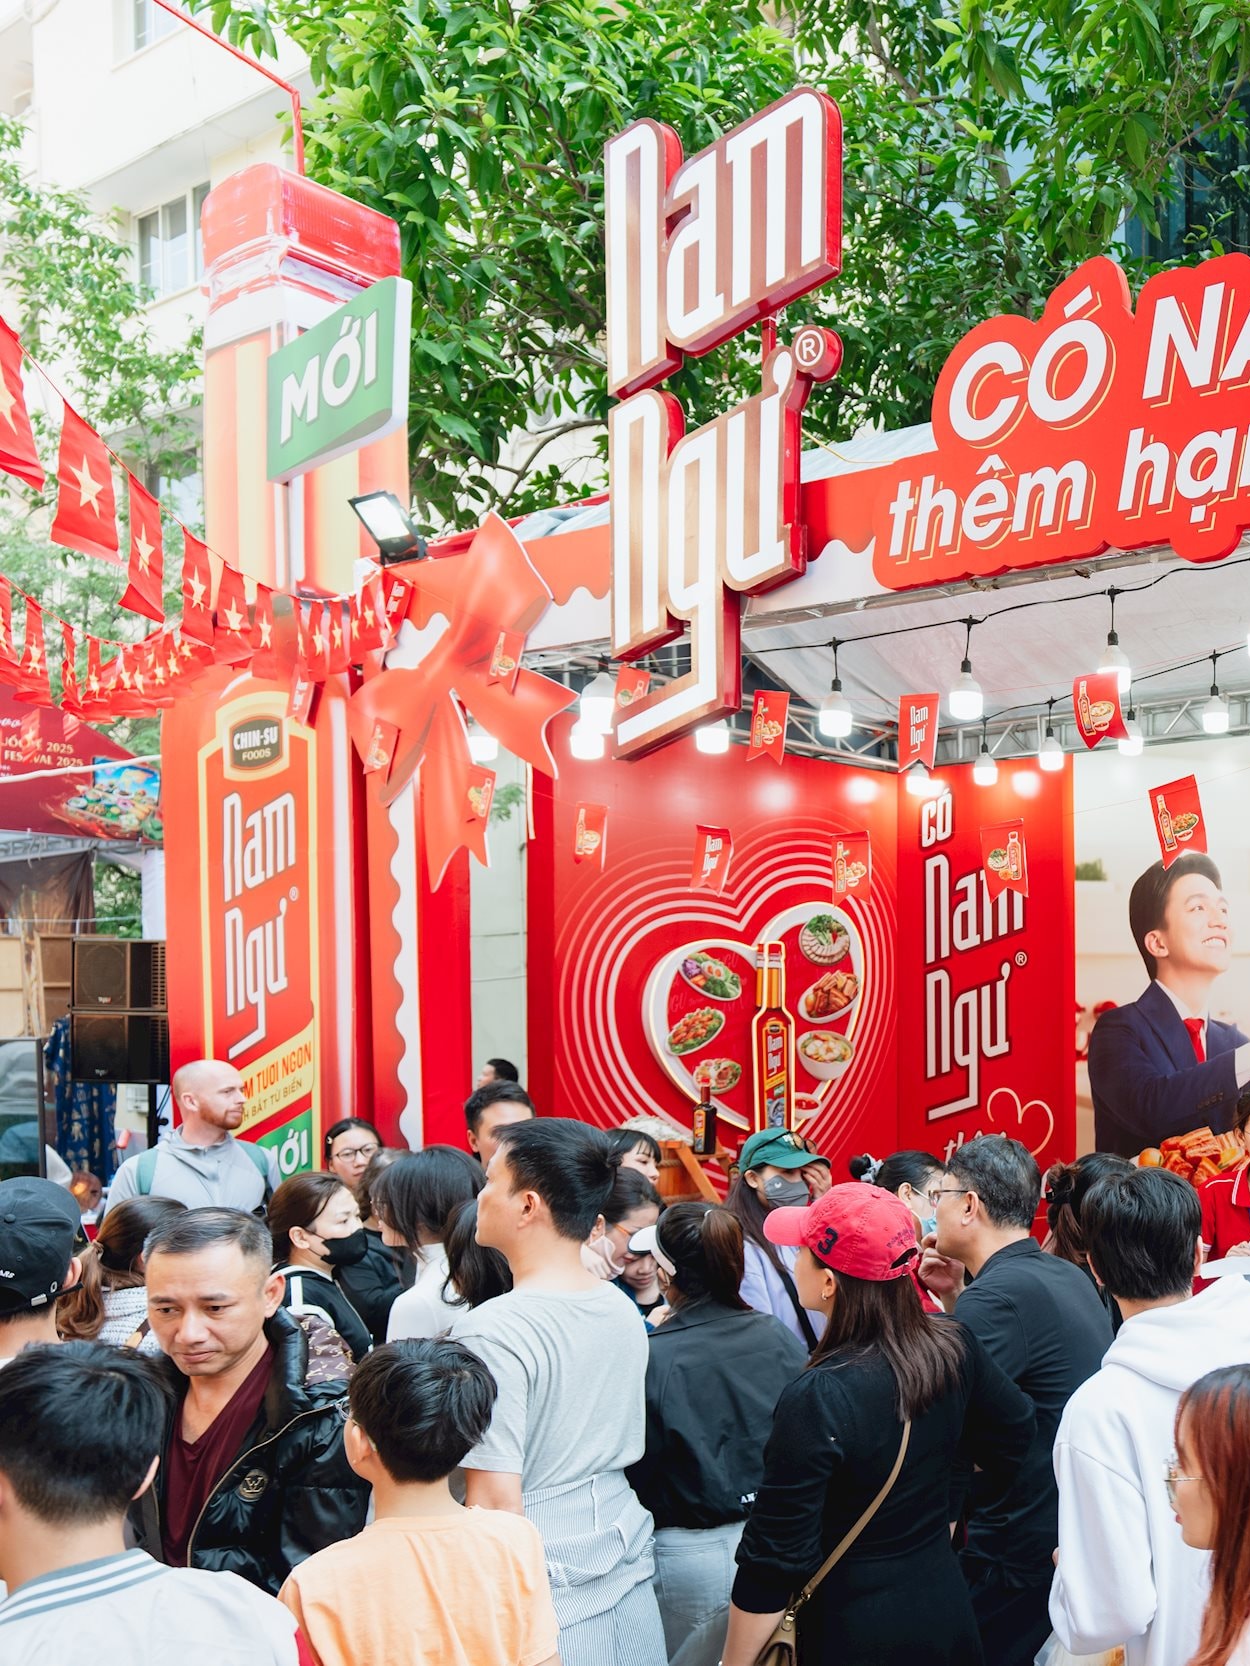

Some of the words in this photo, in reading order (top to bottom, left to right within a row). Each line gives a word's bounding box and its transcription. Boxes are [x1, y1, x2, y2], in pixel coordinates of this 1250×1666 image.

[608, 91, 822, 384] Nam
[280, 310, 377, 445] MỚI
[949, 285, 1108, 442] CÓ
[888, 454, 1089, 557] thêm
[233, 725, 279, 750] CHIN-SU
[242, 748, 271, 761] FOODS
[223, 791, 297, 903] Nam
[925, 854, 1024, 965] Nam
[281, 1041, 312, 1077] NGON
[271, 1128, 308, 1175] ỚI
[817, 1227, 838, 1255] 3
